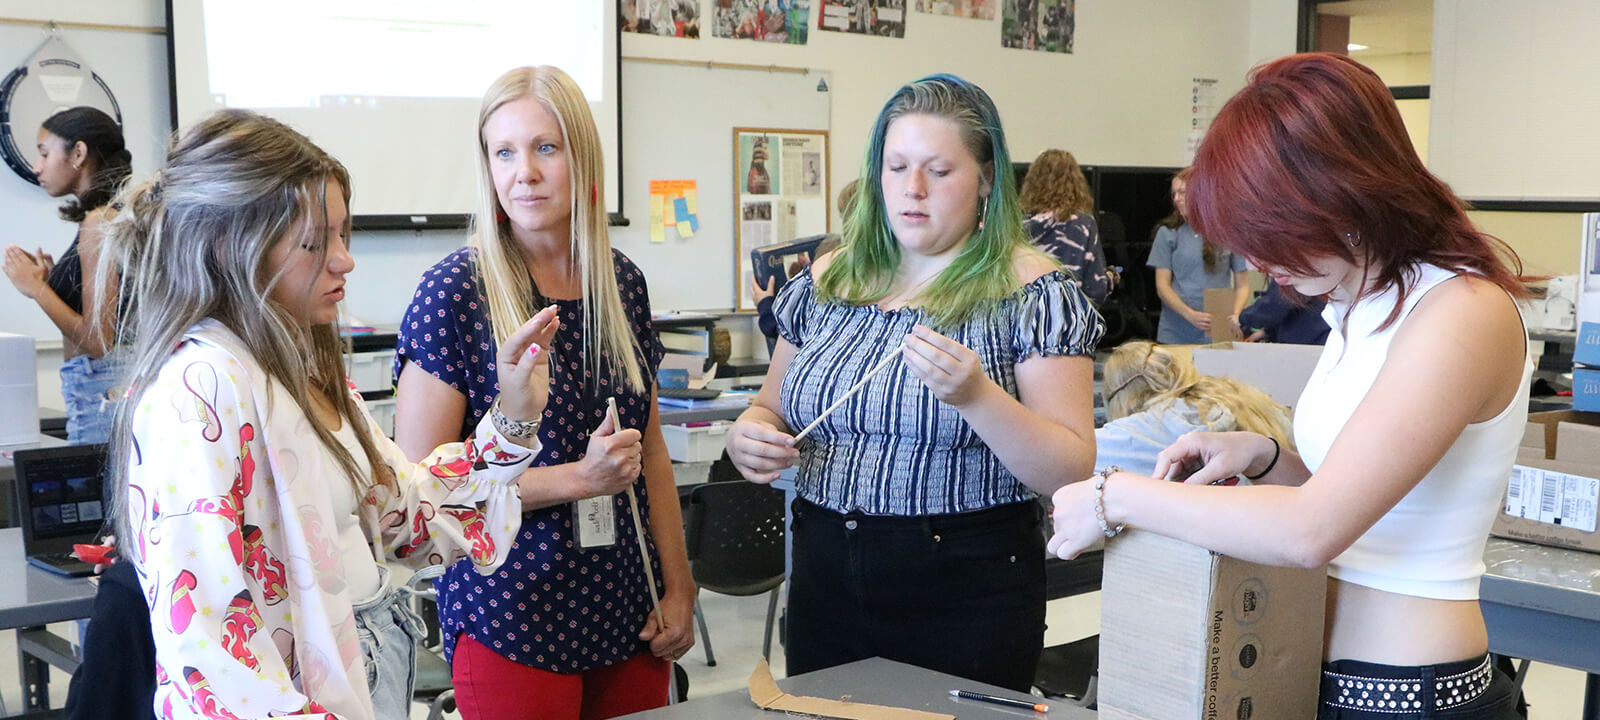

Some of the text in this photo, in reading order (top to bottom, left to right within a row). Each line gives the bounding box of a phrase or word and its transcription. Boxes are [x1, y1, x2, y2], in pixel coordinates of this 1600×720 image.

[1212, 610, 1223, 643] Make
[1212, 646, 1219, 654] a
[1210, 657, 1220, 691] better
